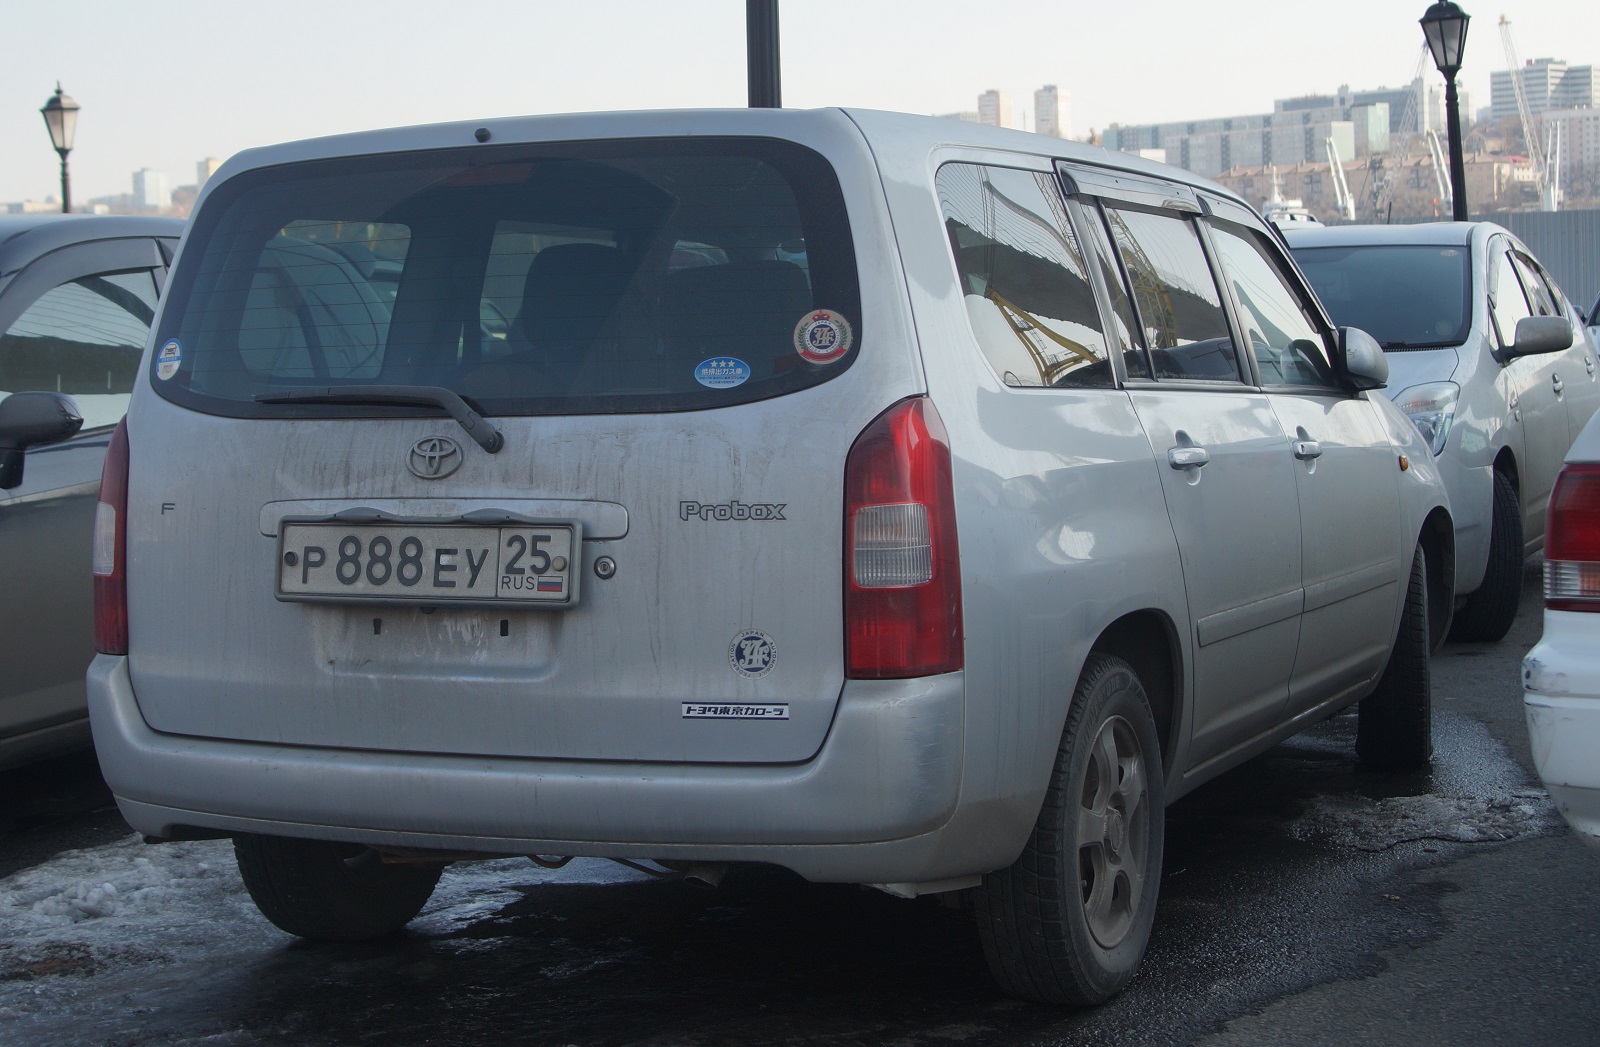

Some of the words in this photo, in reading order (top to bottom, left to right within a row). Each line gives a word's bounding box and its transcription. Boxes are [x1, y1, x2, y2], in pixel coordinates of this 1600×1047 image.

[161, 502, 176, 515] F
[679, 500, 787, 521] Probox
[505, 534, 552, 575] 25
[501, 575, 535, 590] RUS
[741, 630, 765, 638] JAPAN
[686, 706, 785, 716] トヨタ東京カローラ
